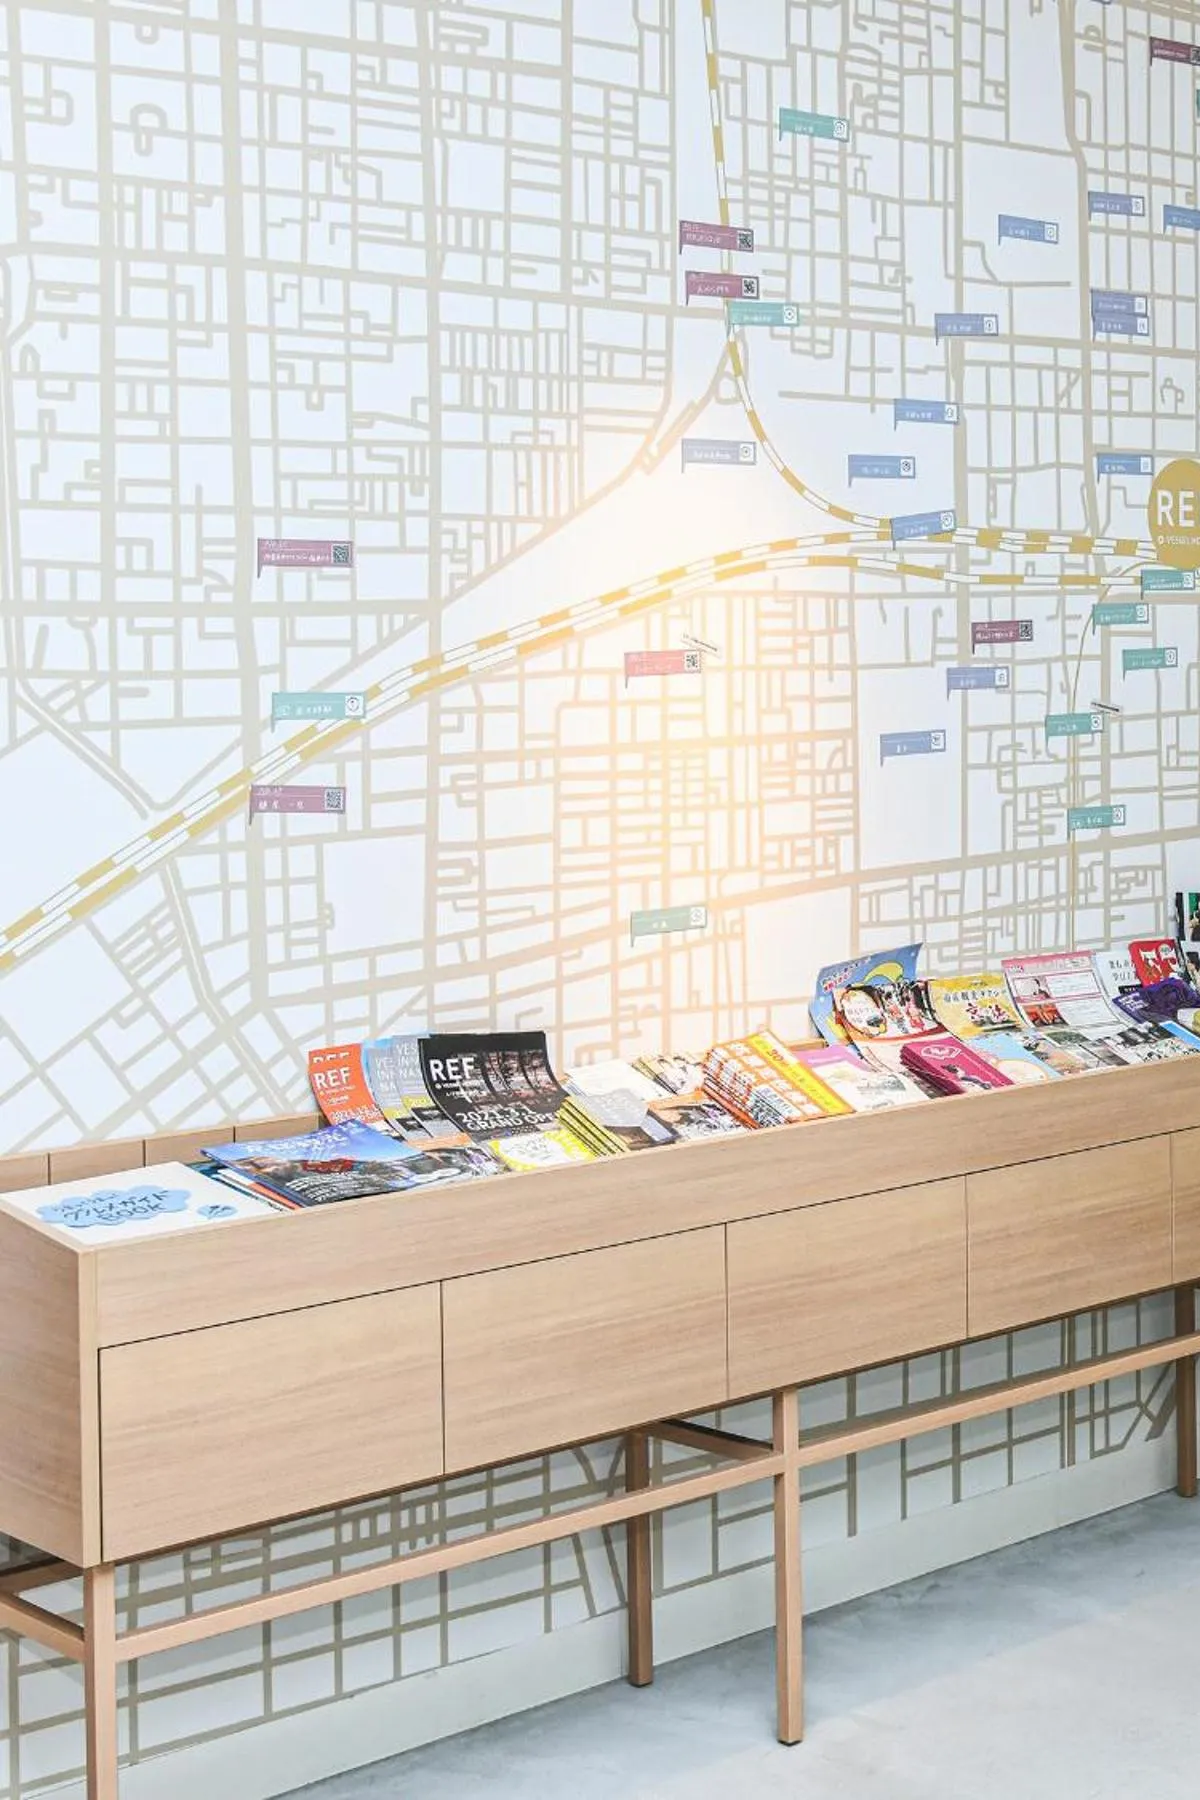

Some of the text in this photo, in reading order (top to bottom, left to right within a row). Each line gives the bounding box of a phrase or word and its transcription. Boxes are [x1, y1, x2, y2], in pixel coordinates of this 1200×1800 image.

[314, 1066, 350, 1090] REF
[430, 1057, 474, 1081] REF
[467, 1112, 555, 1131] GRAND OPE
